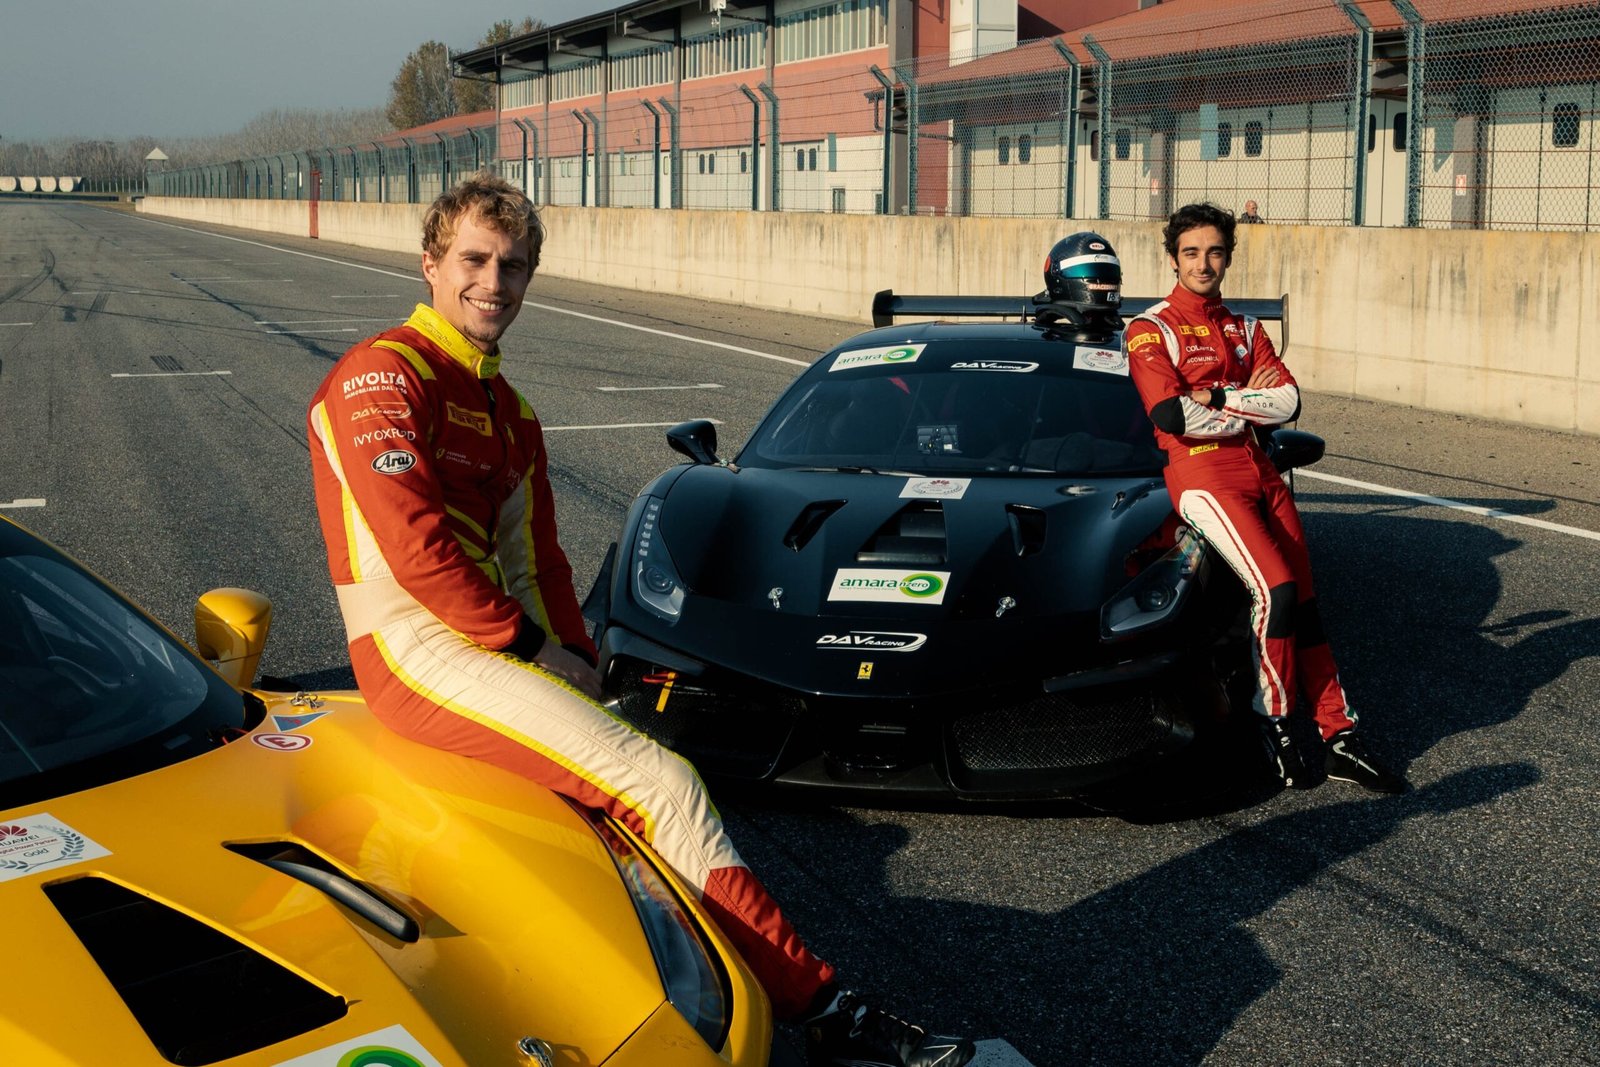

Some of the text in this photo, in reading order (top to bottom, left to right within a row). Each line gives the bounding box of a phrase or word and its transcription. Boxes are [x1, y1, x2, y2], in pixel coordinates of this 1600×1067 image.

[838, 353, 881, 365] amara
[343, 371, 407, 394] RIVOLTA
[344, 385, 380, 400] IMMOBILIARE
[351, 407, 381, 421] DAV
[353, 431, 373, 448] IVY
[376, 453, 409, 470] Arai
[840, 579, 898, 588] amara
[816, 635, 875, 645] DAV
[23, 848, 50, 857] Gold
